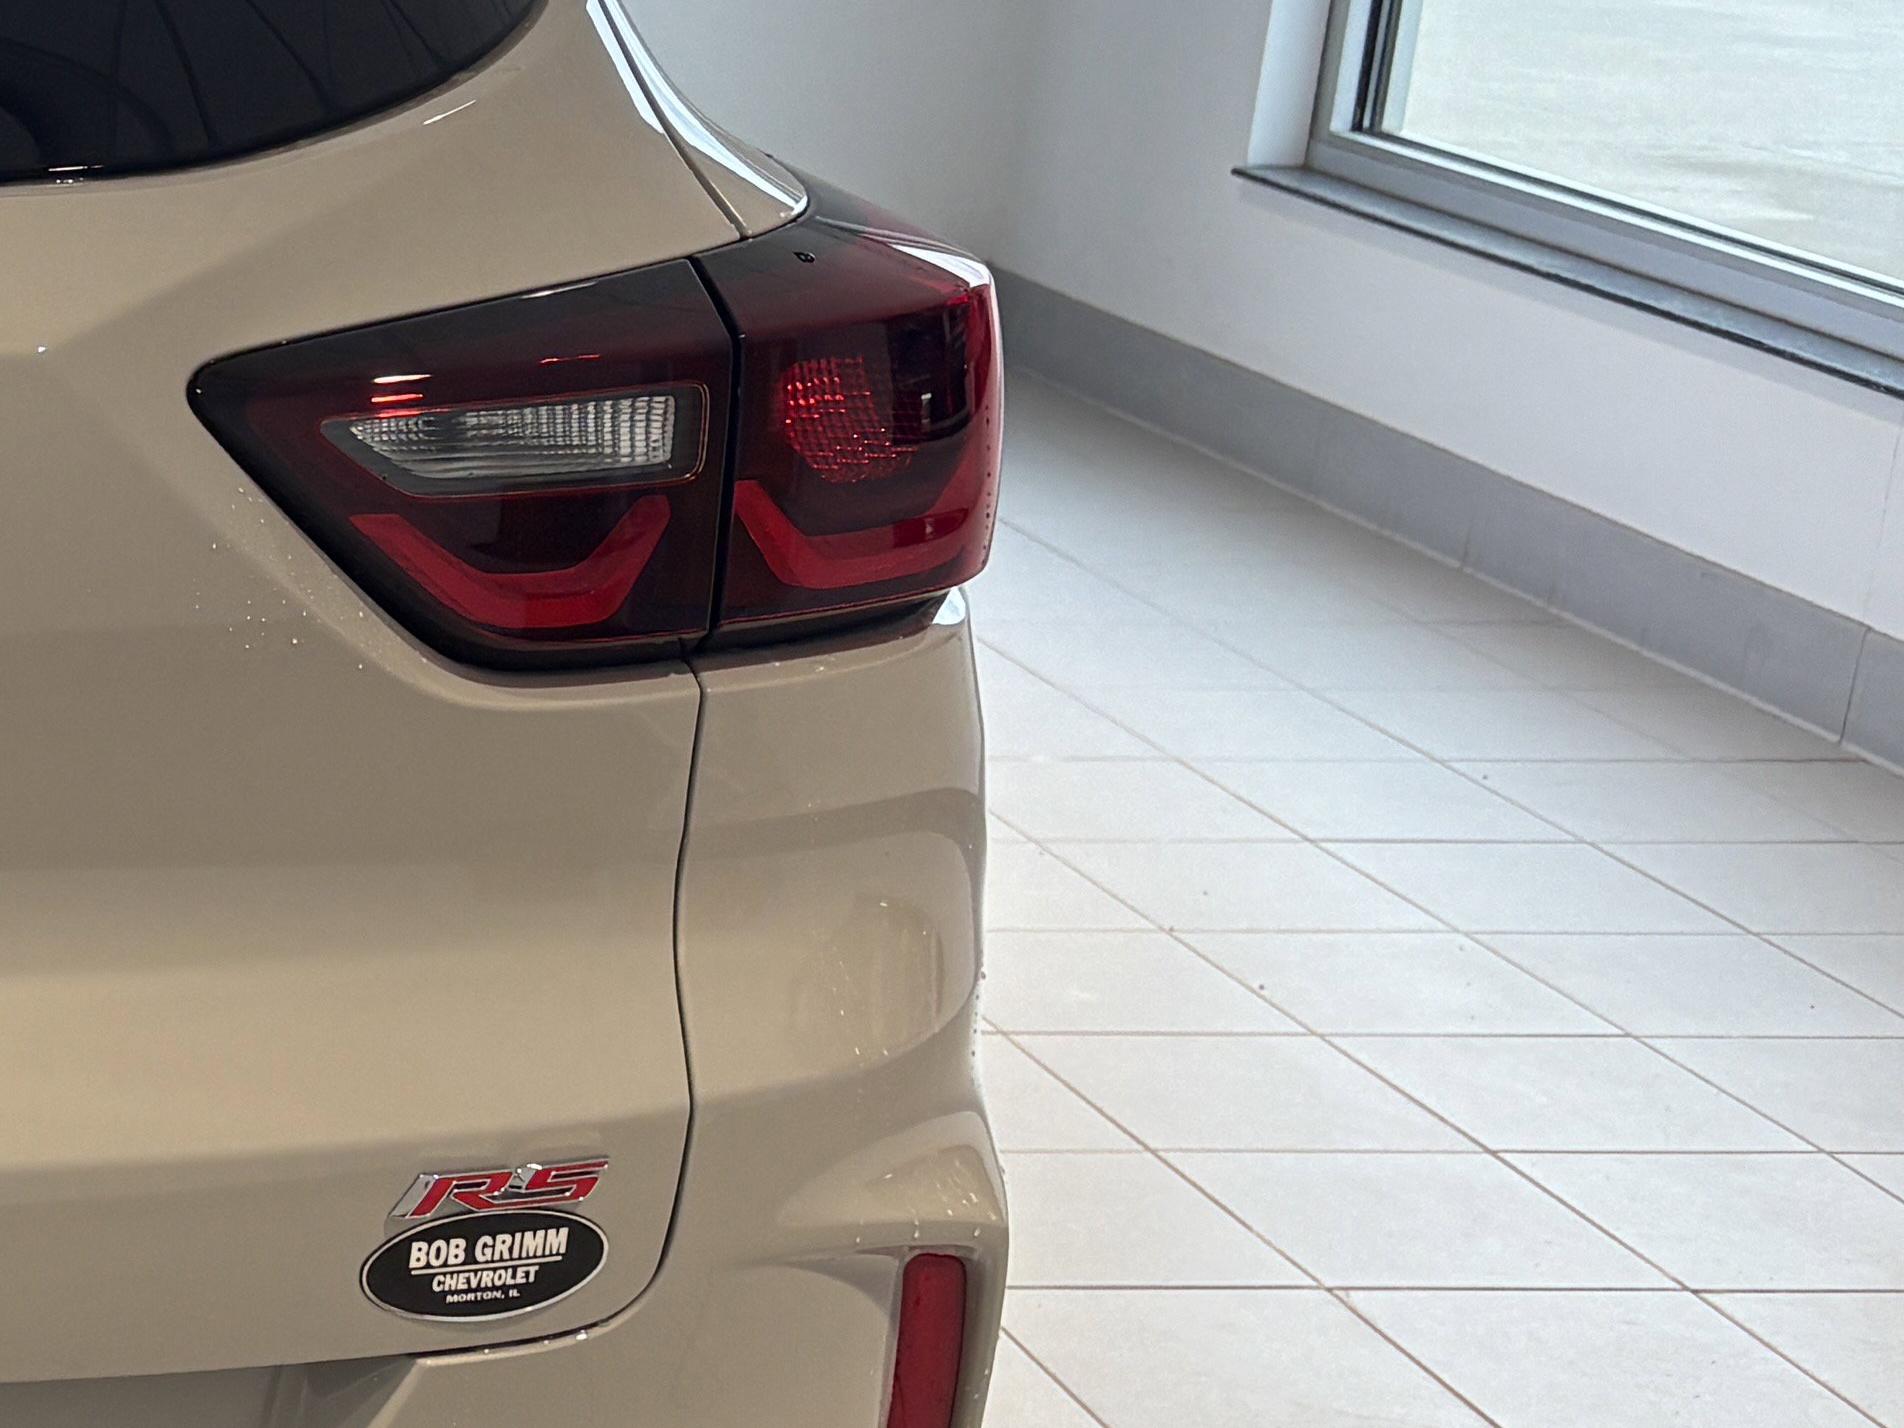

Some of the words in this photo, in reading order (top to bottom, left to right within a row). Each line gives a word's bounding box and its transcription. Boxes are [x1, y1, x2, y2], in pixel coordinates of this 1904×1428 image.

[389, 1156, 610, 1219] RS
[408, 1237, 467, 1269] BOB
[474, 1226, 570, 1264] GRIMM
[431, 1265, 540, 1293] CHEVROLET
